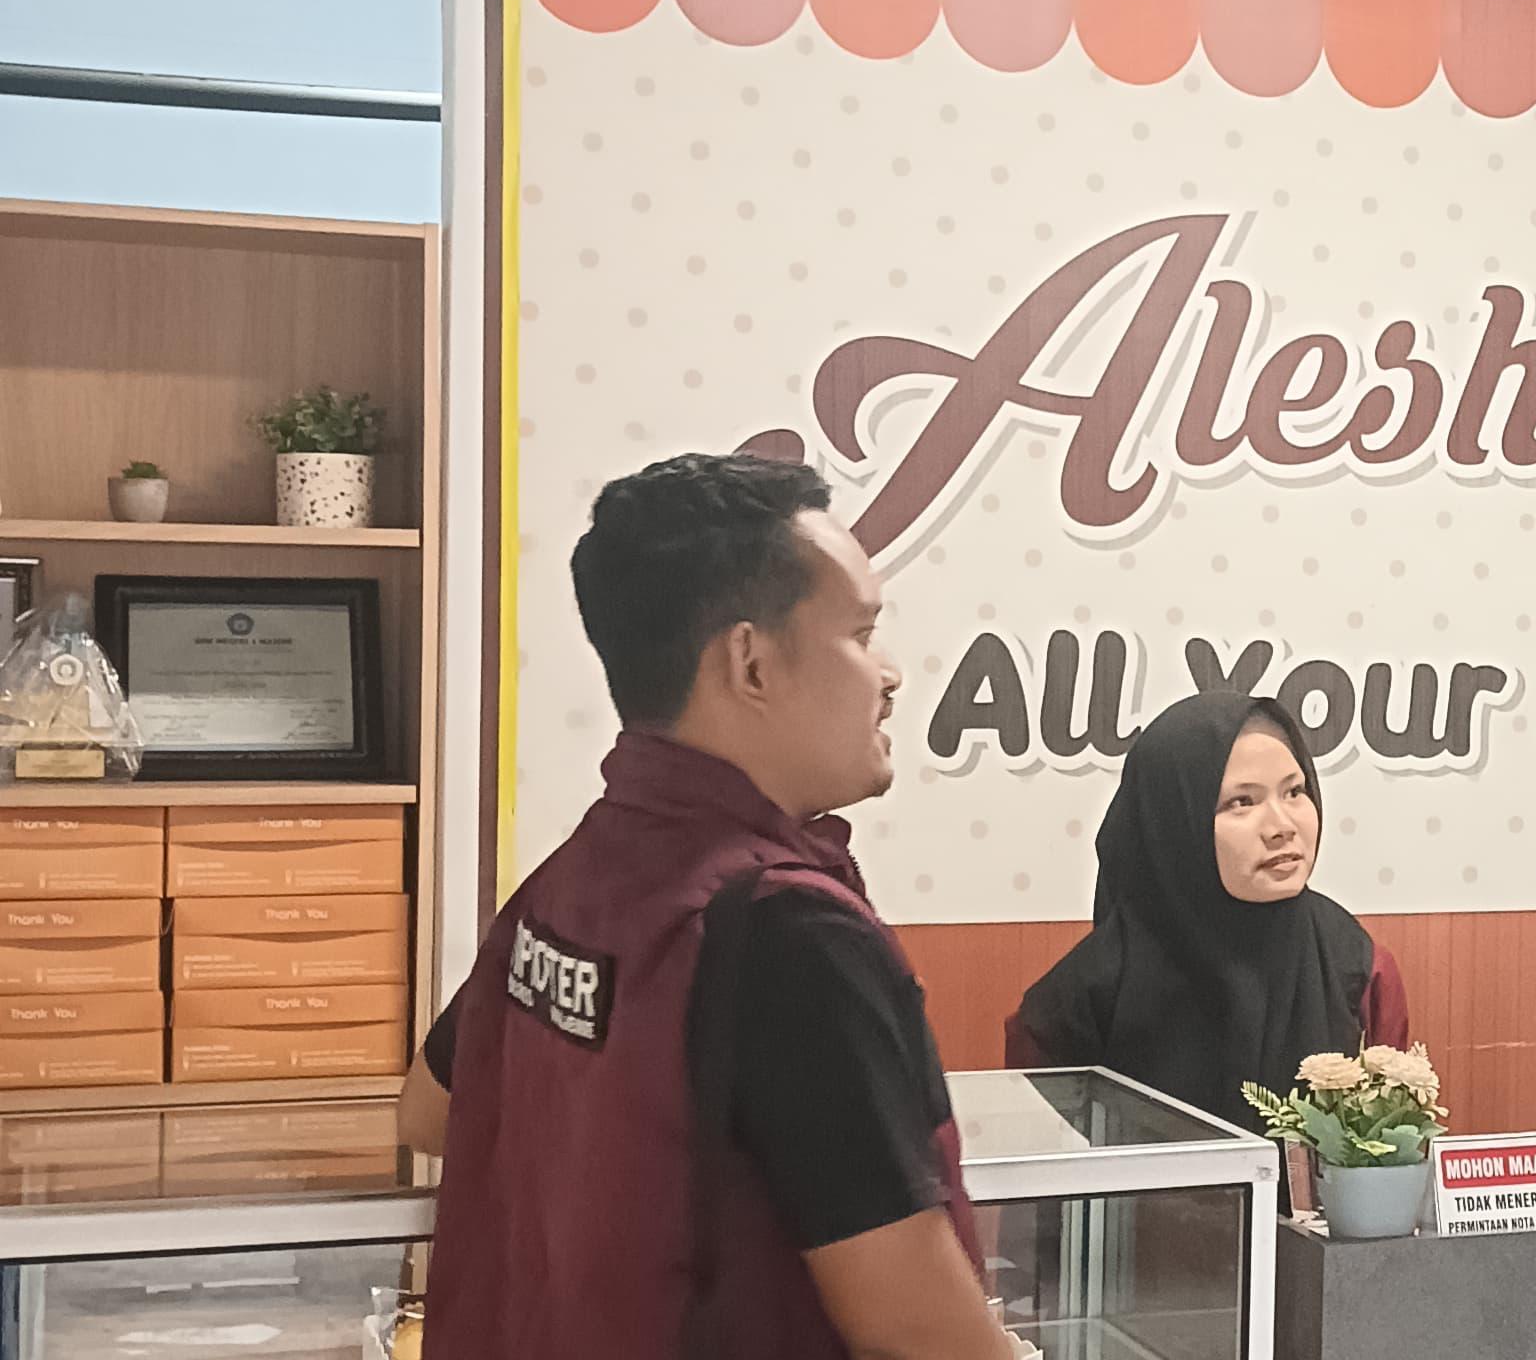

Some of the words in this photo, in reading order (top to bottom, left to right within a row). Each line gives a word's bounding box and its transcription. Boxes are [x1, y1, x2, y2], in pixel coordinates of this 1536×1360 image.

[928, 629, 1141, 758] All
[8, 913, 44, 925] Thank
[51, 913, 74, 925] You
[265, 908, 300, 920] Thank
[306, 908, 328, 920] You
[266, 997, 300, 1009] Thank
[306, 997, 328, 1009] You
[11, 1008, 48, 1020] Thank
[53, 1008, 77, 1020] You
[1445, 1156, 1506, 1180] MOHON
[1454, 1195, 1492, 1213] TIDAK
[1448, 1218, 1509, 1234] PERMINTAAN
[1511, 1216, 1535, 1231] NOTA
